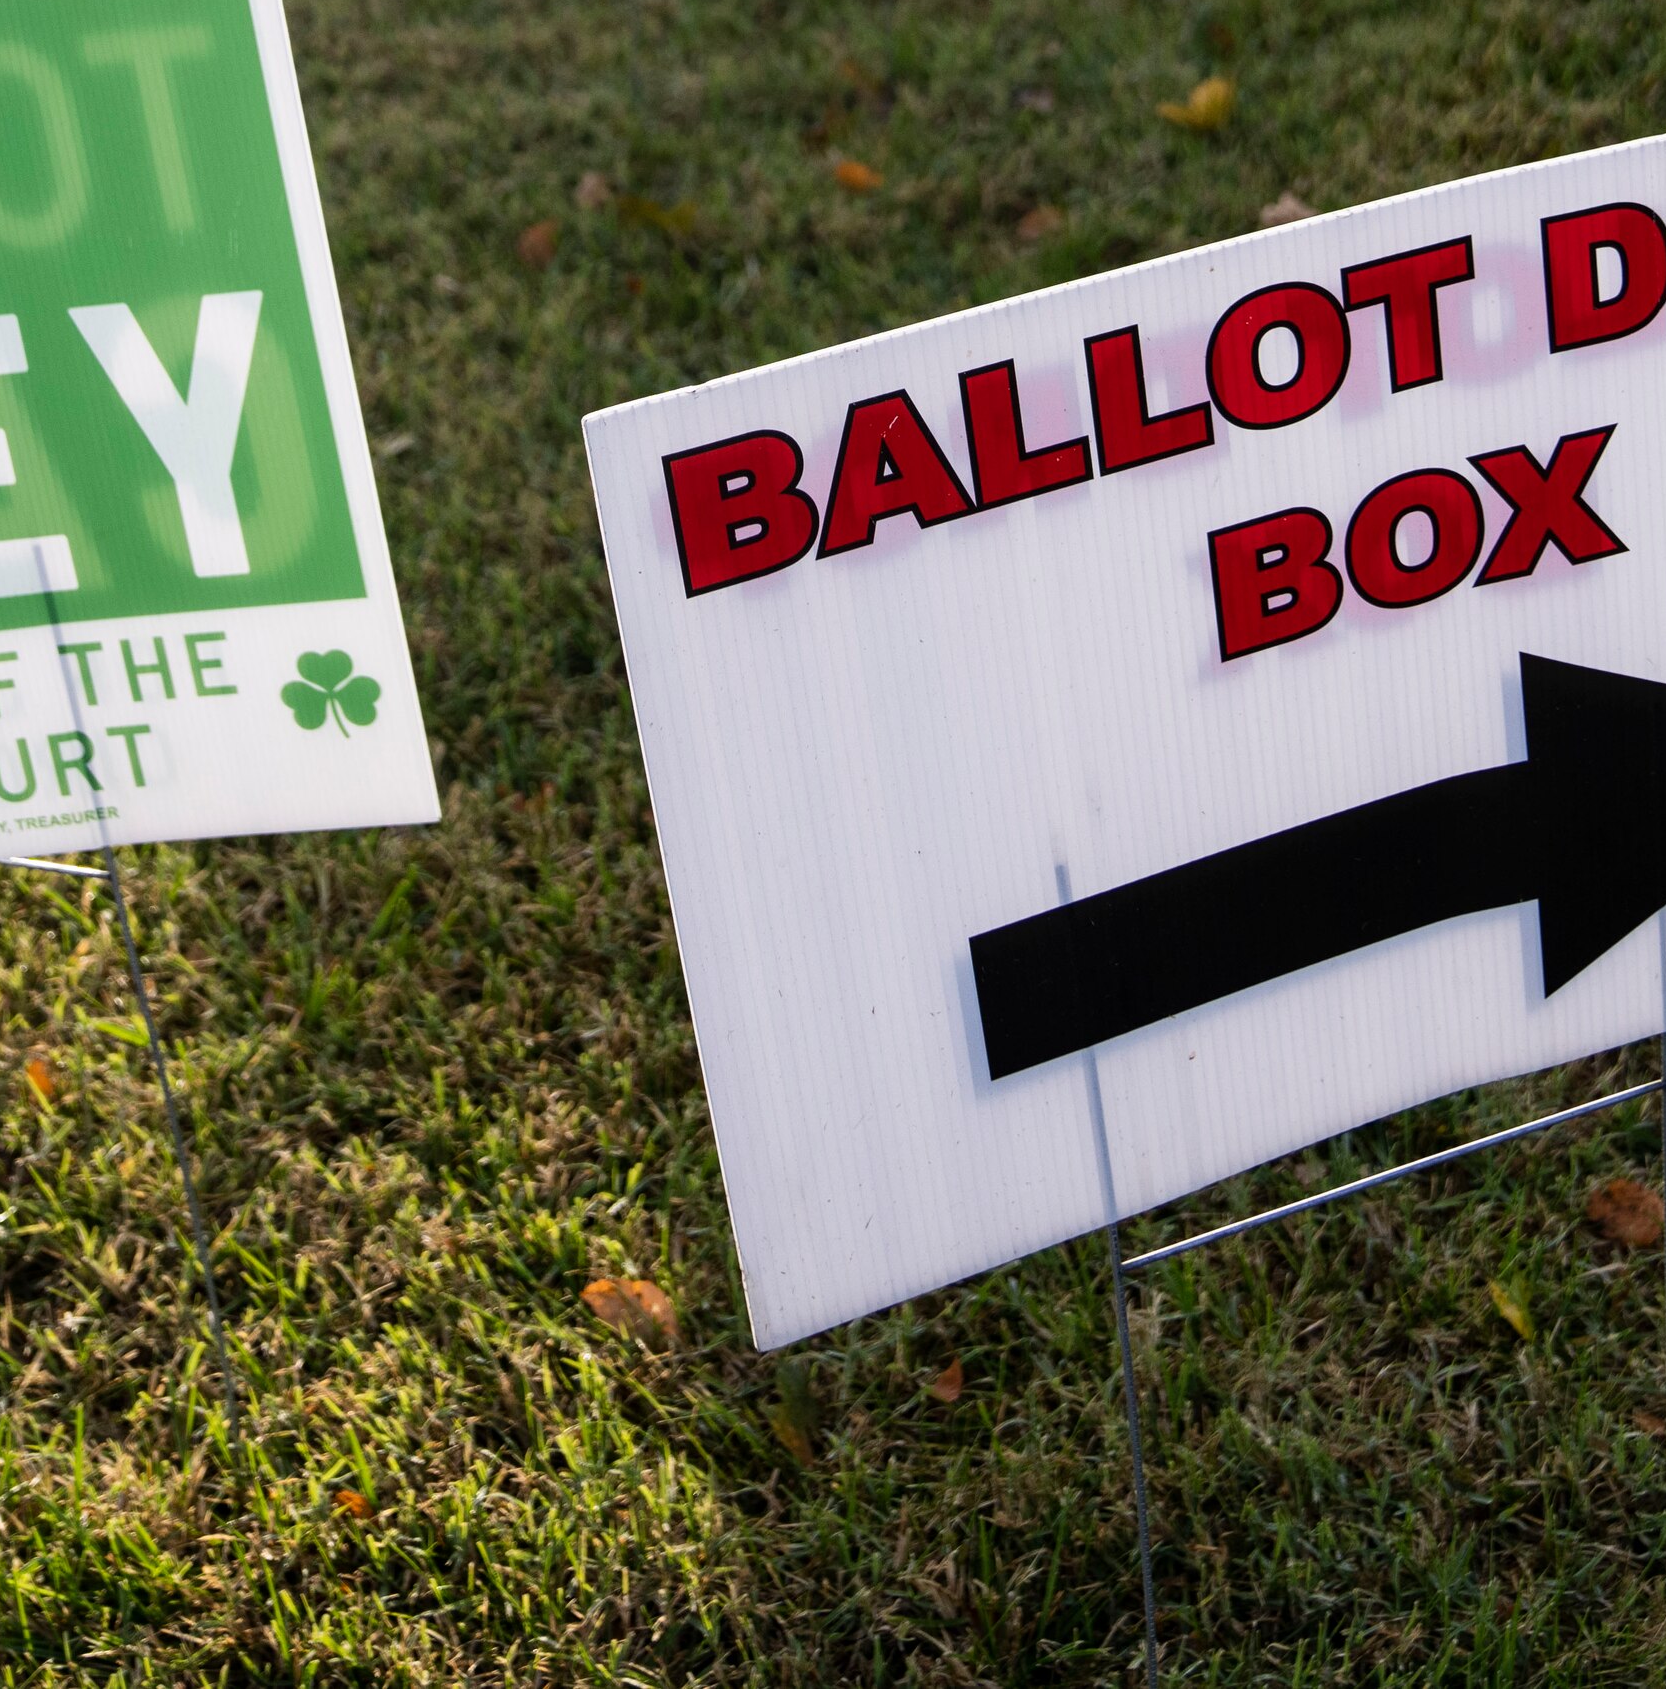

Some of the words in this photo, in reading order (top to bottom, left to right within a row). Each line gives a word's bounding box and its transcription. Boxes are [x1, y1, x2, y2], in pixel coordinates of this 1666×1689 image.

[662, 235, 1476, 598] BALLOT
[1207, 422, 1629, 664] BOX
[57, 632, 239, 706] THE
[15, 806, 119, 830] TREASURER
